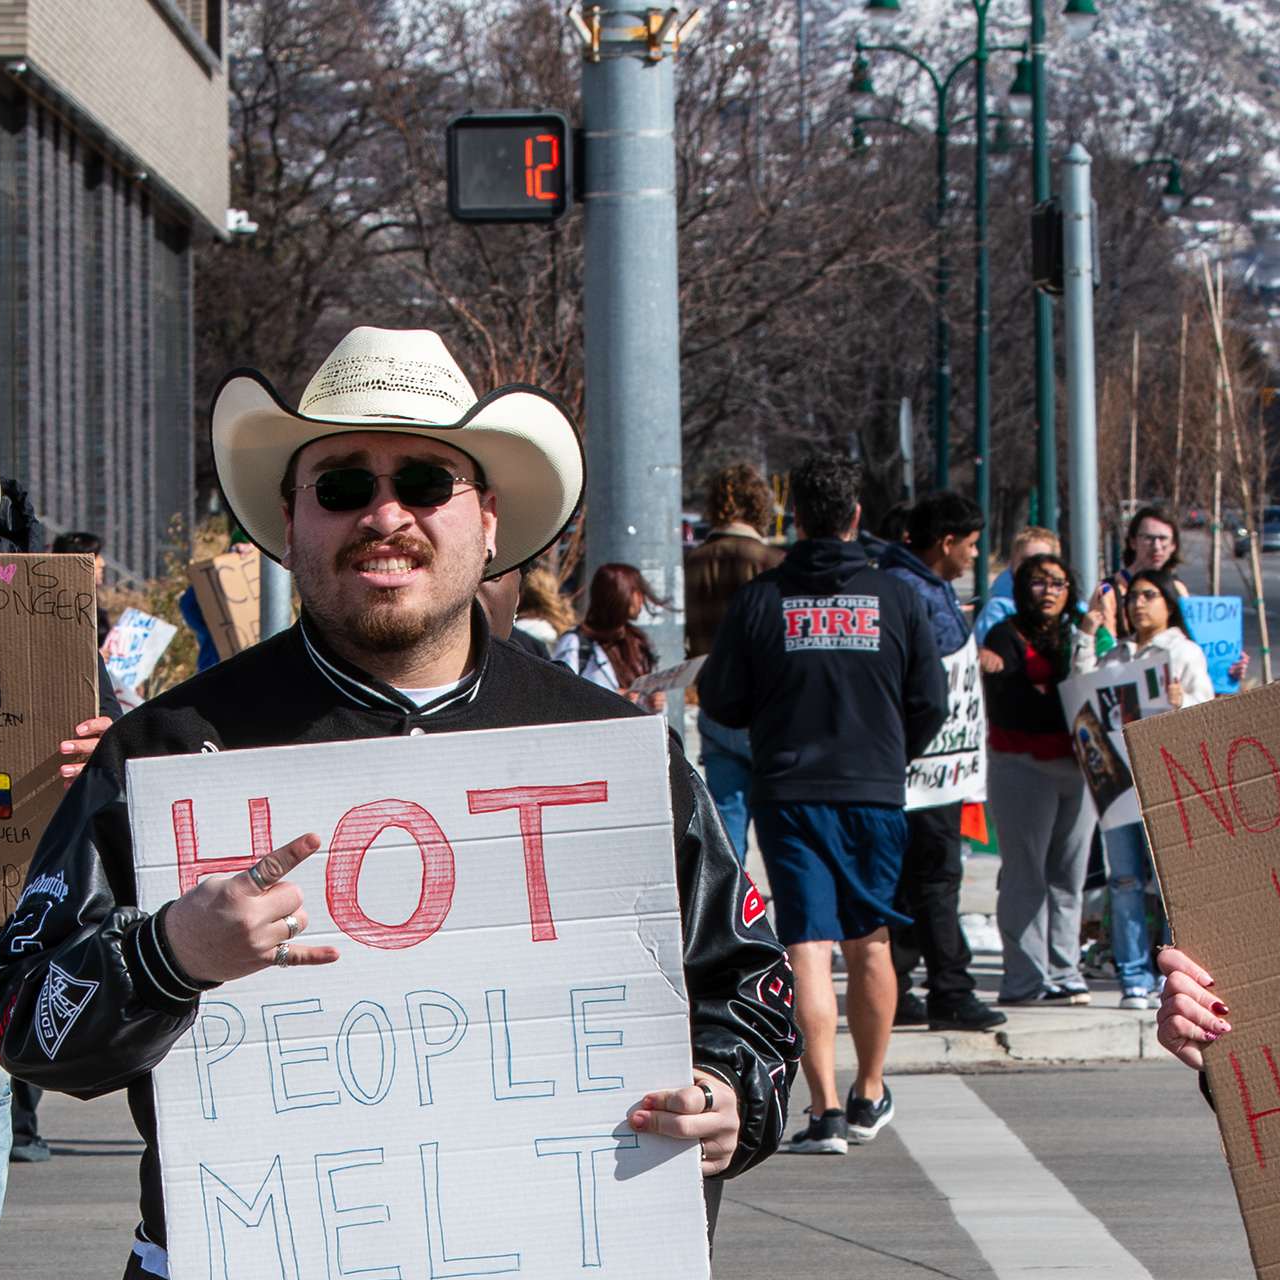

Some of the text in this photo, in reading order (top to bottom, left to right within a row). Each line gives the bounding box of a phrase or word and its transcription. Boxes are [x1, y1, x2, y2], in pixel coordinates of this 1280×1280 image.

[524, 134, 559, 200] 12
[24, 560, 59, 589] IS
[782, 597, 880, 609] CITY OF OREM
[1184, 601, 1240, 625] ATION
[783, 608, 881, 638] FIRE
[785, 637, 880, 649] DEPARTMENT
[172, 780, 609, 951] HOT
[192, 985, 627, 1122] PEOPLE
